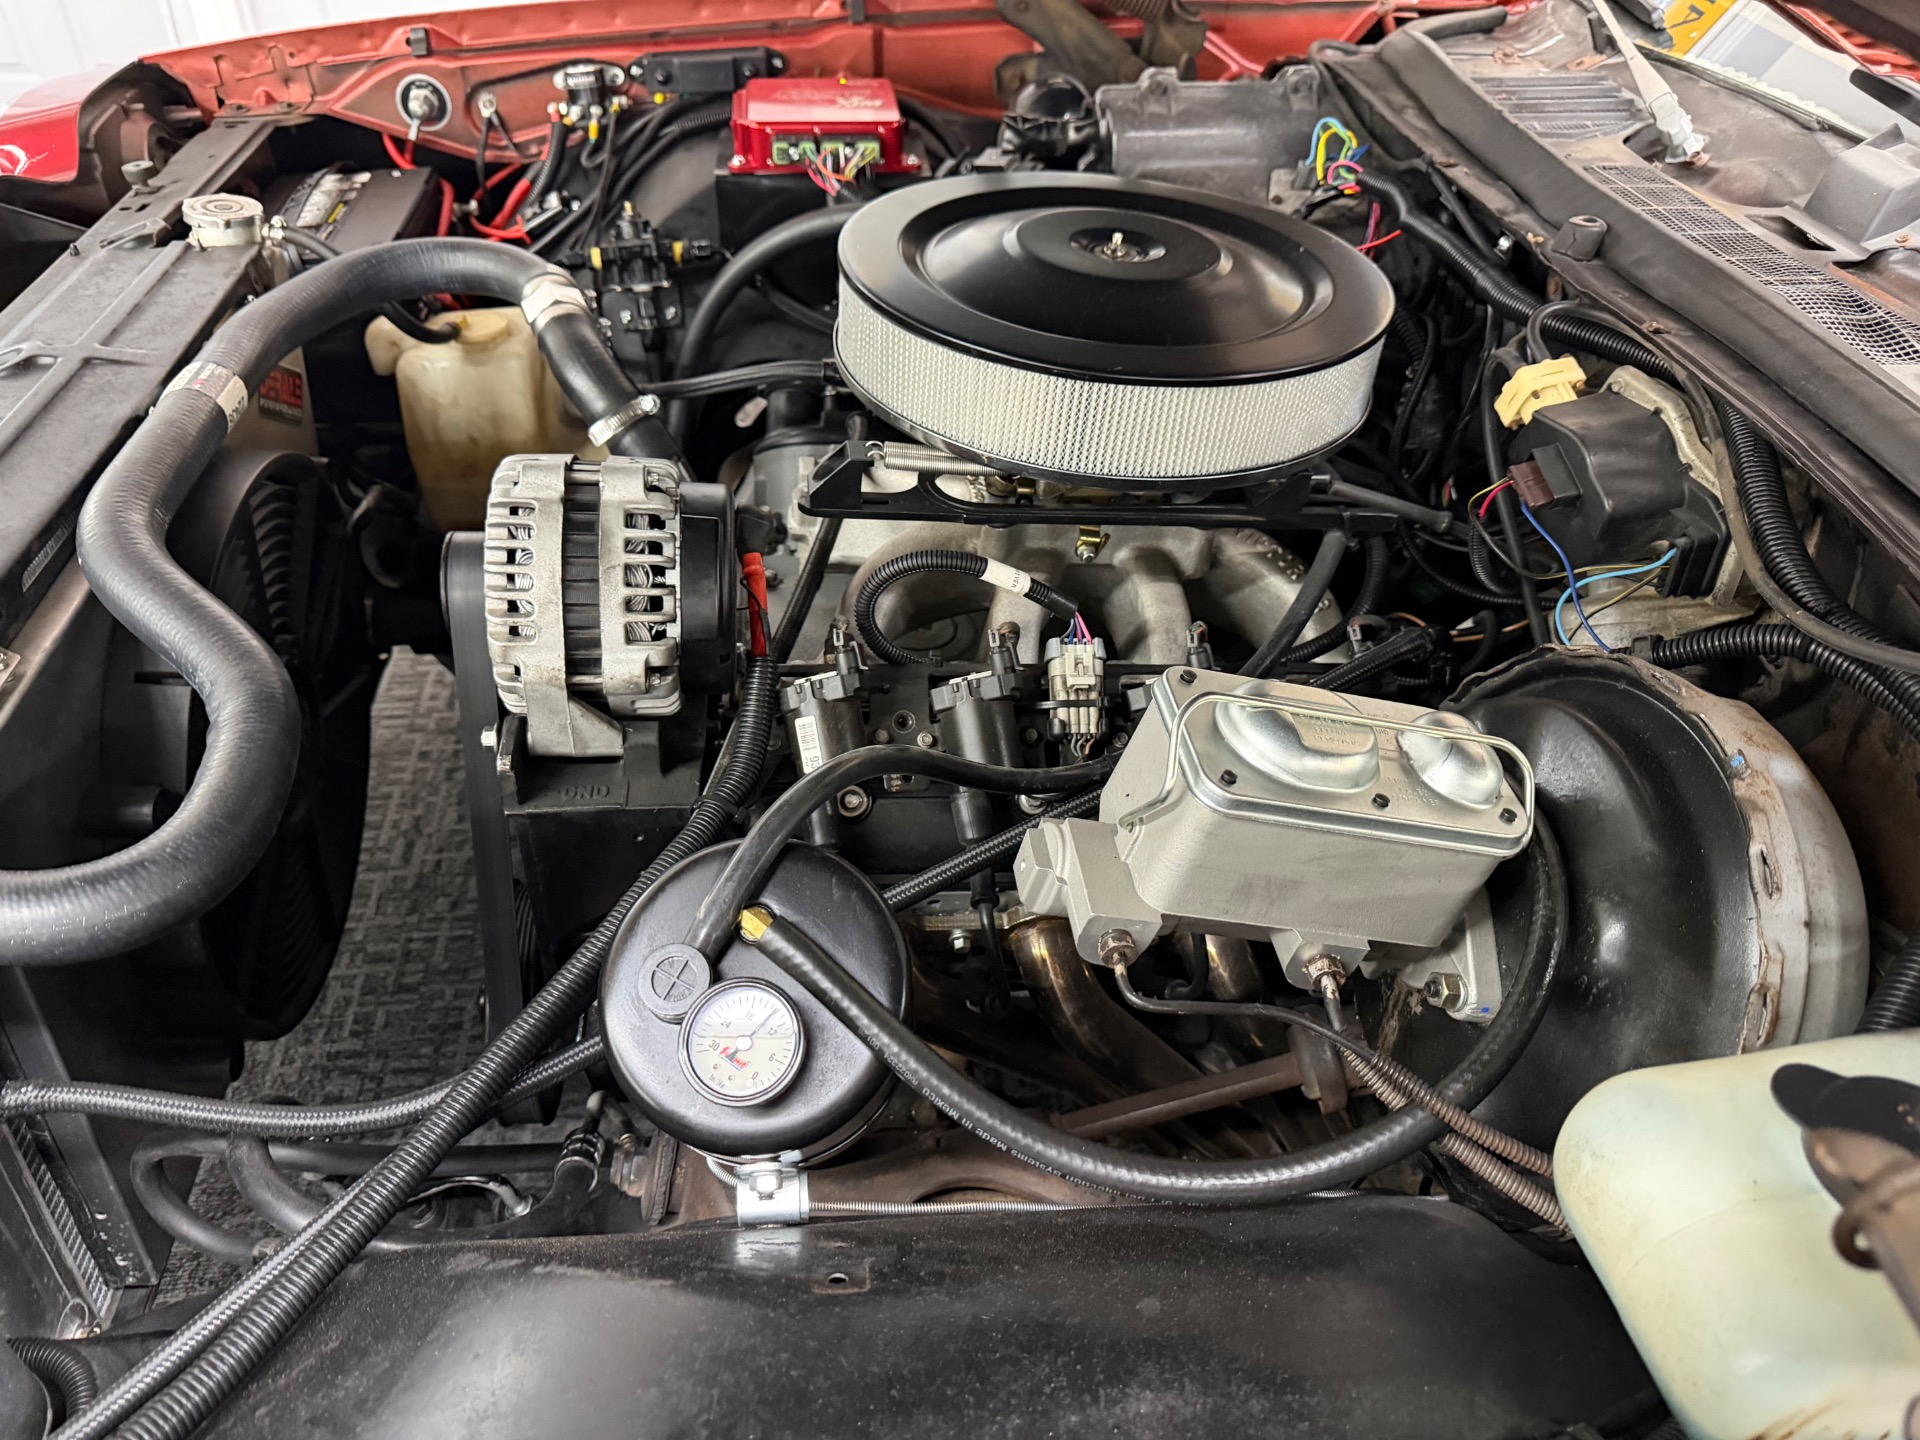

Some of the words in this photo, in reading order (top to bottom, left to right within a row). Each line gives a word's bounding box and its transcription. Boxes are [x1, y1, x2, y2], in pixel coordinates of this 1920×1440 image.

[744, 1010, 756, 1021] 18
[720, 1017, 732, 1029] 24
[767, 1027, 778, 1036] 12
[708, 1039, 720, 1051] 30
[768, 1053, 776, 1062] 6
[751, 1071, 759, 1080] 0
[922, 1086, 960, 1120] Mexico
[975, 1127, 1008, 1152] Made
